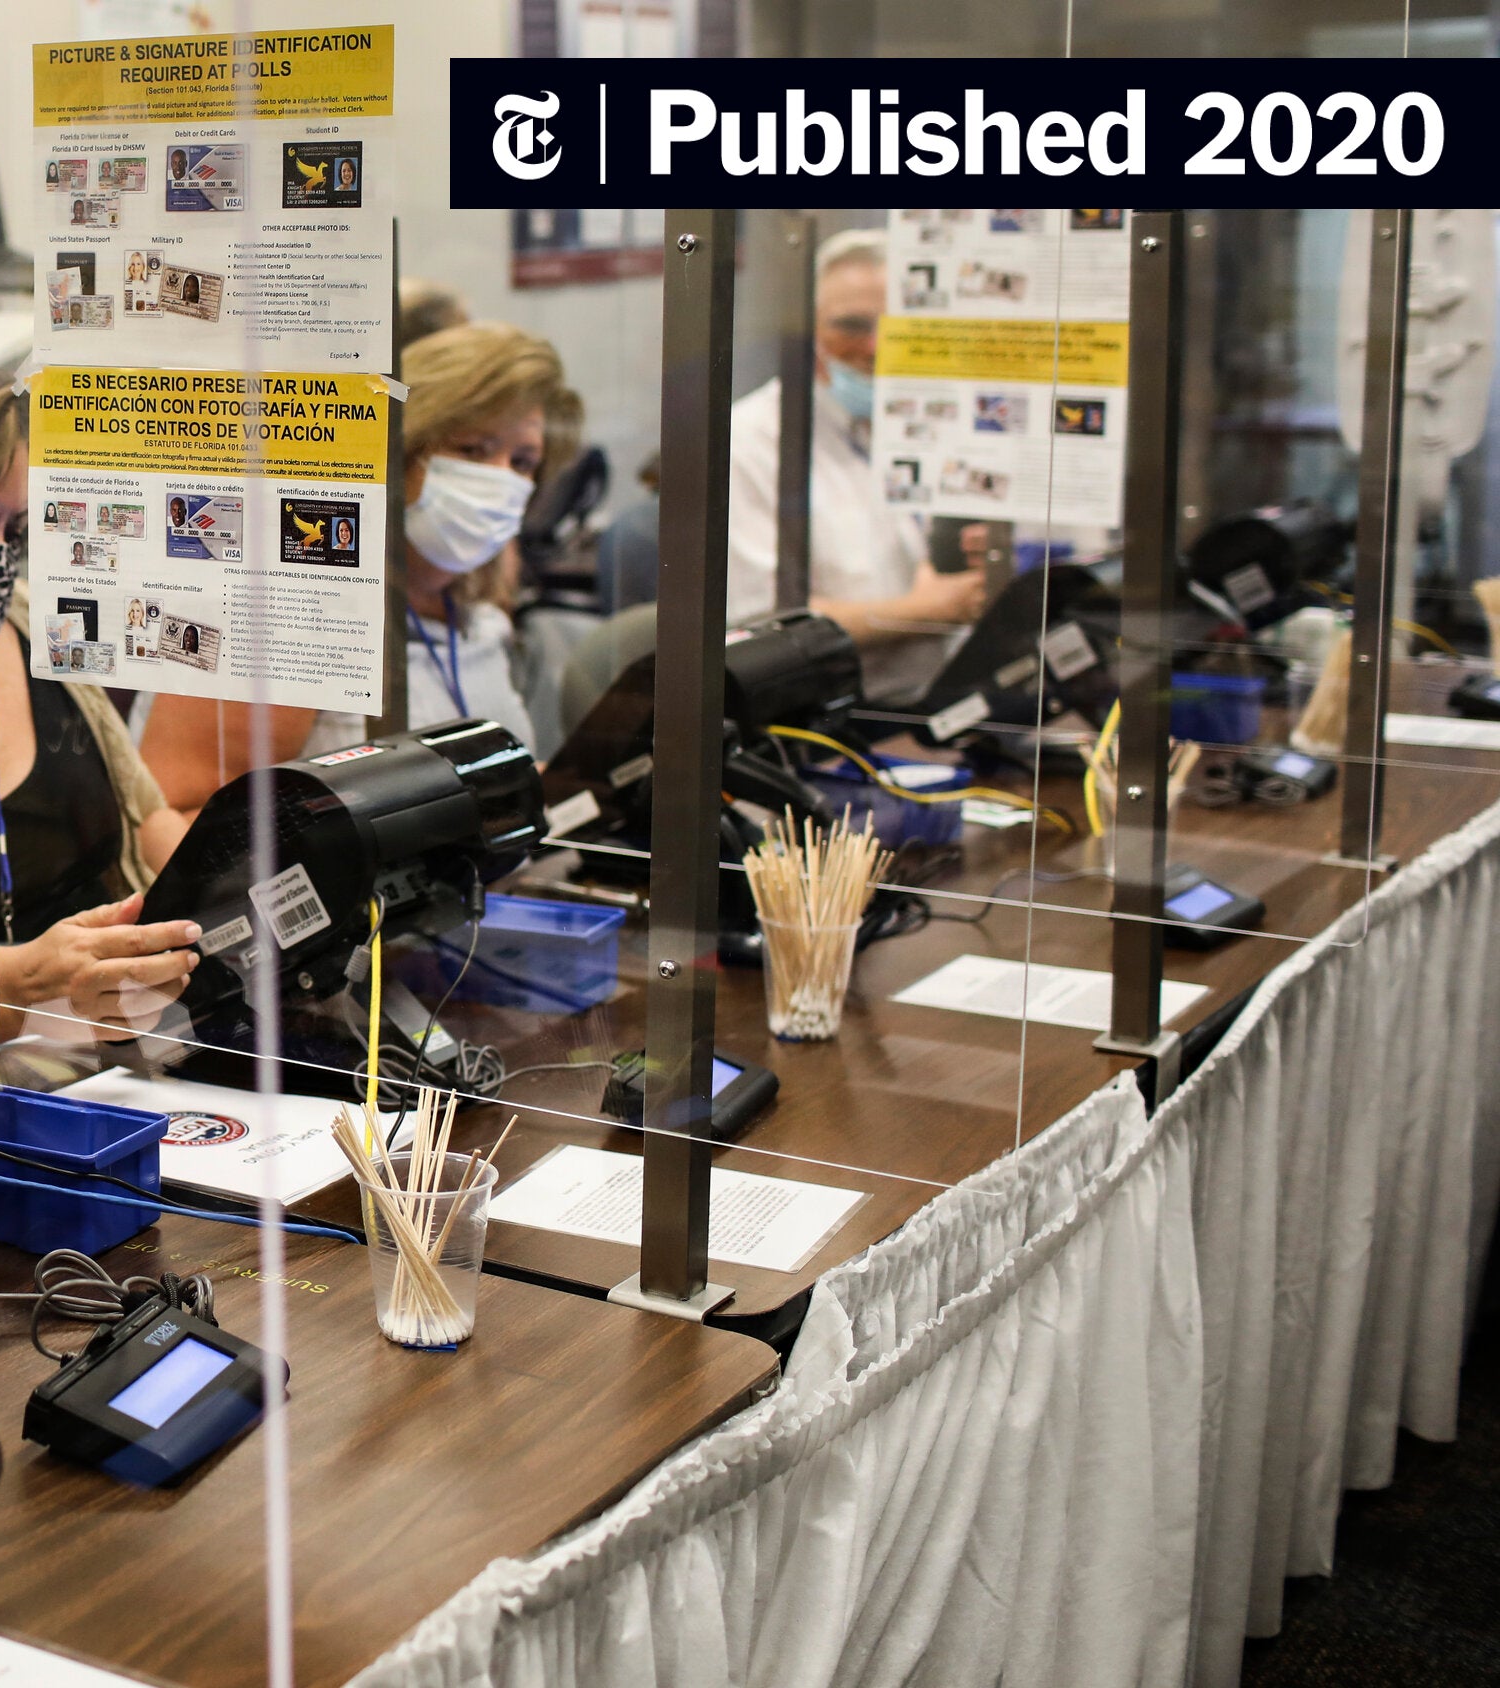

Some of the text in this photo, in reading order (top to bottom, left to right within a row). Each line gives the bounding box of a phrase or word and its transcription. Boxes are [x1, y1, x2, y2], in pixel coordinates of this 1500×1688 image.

[50, 34, 371, 64] PICTURE & SIGNATURE IDENTIFICATION
[121, 61, 291, 83] REQUIRED AT POLLS
[146, 87, 173, 96] (Section
[177, 86, 203, 94] 101.043,
[114, 144, 121, 152] by
[225, 199, 242, 207] VISA
[86, 236, 110, 244] Passport
[72, 374, 338, 396] ES NECESARIO PRESENTAR UNA
[40, 394, 377, 420] IDENTIFICACIÓN CON FOTOGRAFÍA Y FIRMA
[75, 418, 335, 442] EN LOS CENTROS DE VOTACIÓN
[145, 440, 181, 448] ESTATUTO
[194, 442, 225, 450] FLORIDA
[75, 487, 112, 495] identificación
[122, 489, 142, 497] Florida
[277, 487, 319, 496] identificación
[330, 490, 364, 499] estudiante
[224, 550, 240, 558] VISA
[48, 575, 77, 584] pasaporte
[309, 573, 350, 582] IDENTIFICACIÓN
[142, 582, 182, 591] identificación
[344, 690, 363, 698] English
